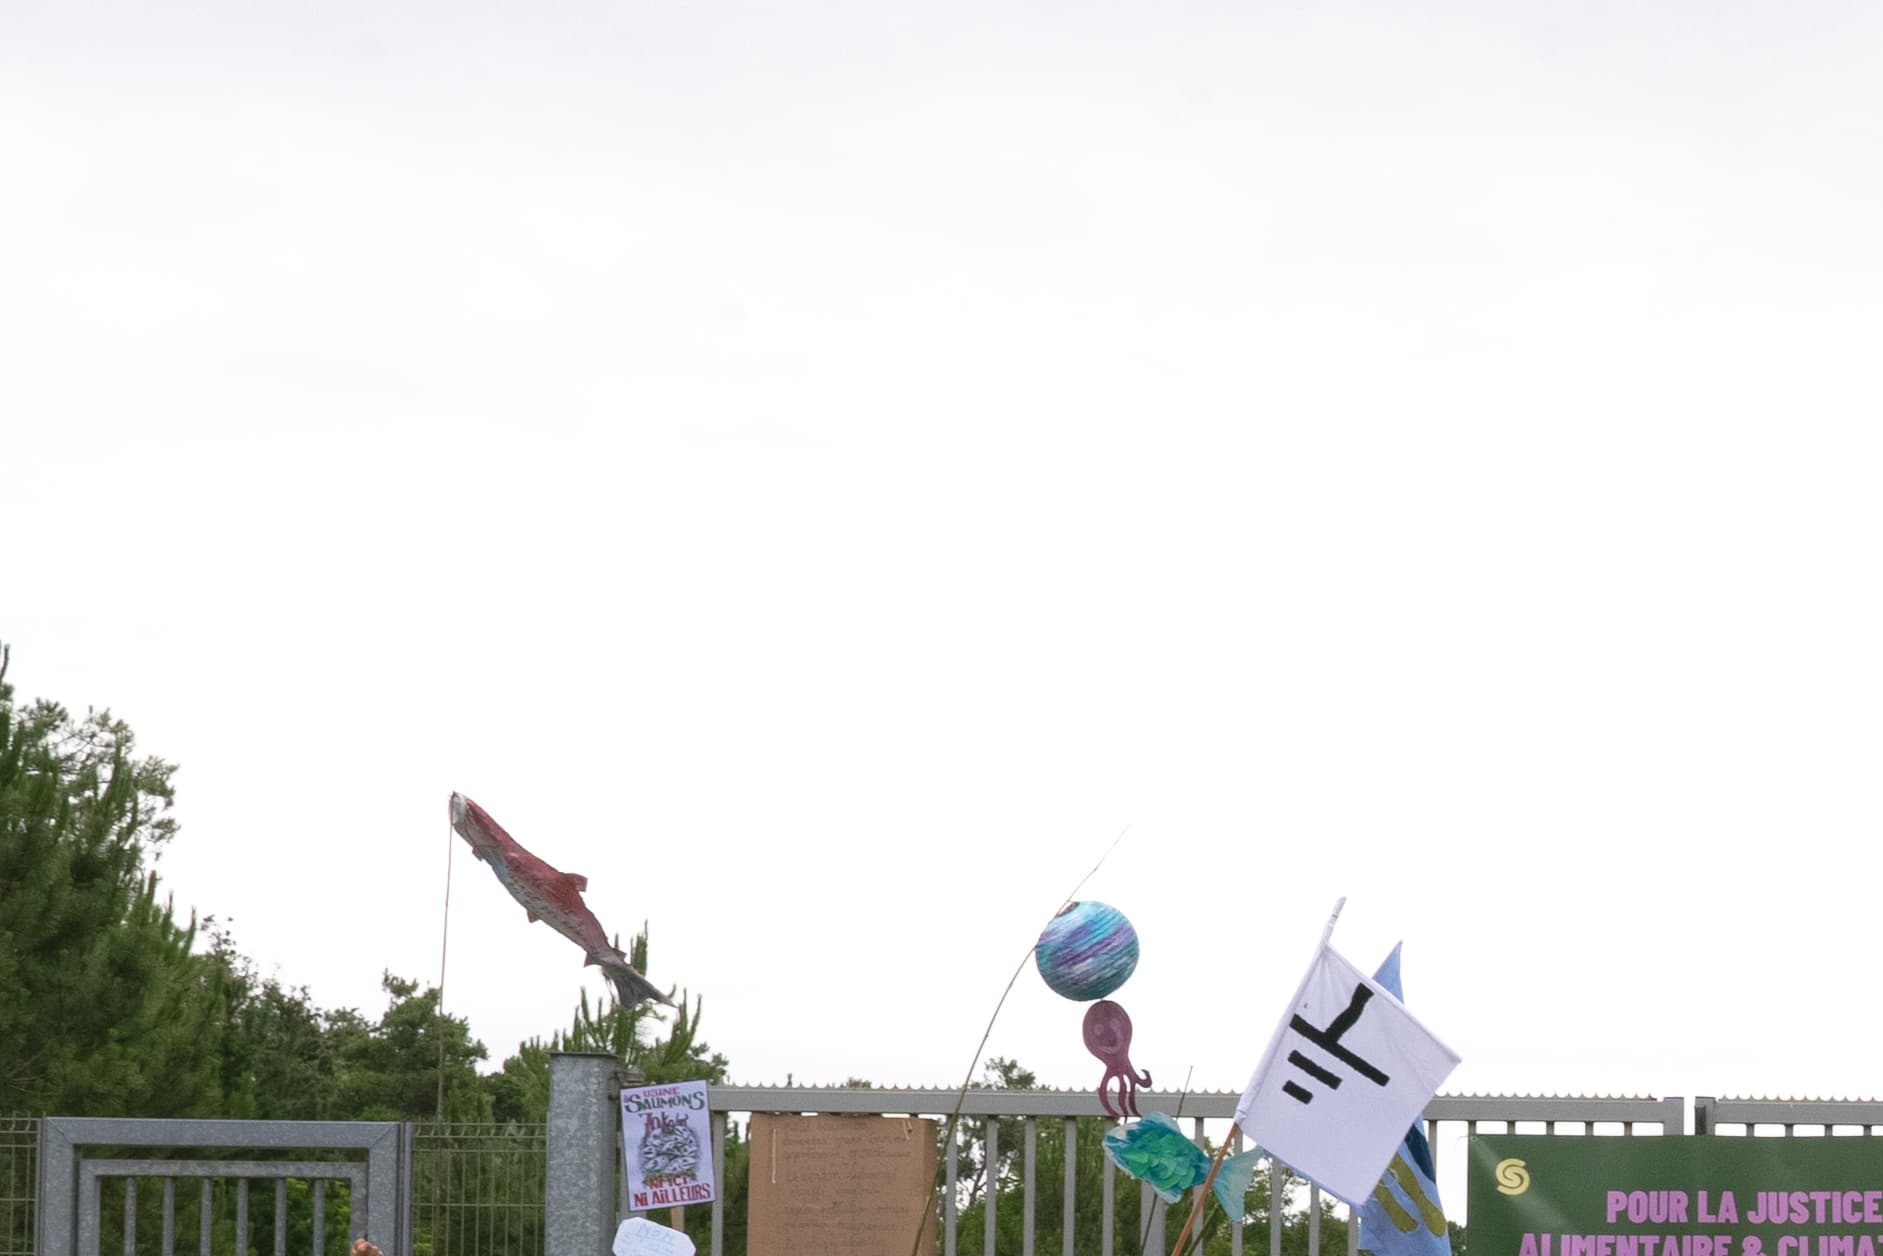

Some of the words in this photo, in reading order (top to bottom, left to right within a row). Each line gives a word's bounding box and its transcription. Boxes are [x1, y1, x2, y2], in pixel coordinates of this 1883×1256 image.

[625, 1091, 704, 1112] SAUMONS
[643, 1087, 680, 1097] USINE
[1606, 1190, 1688, 1224] POUR
[1697, 1190, 1739, 1224] LA
[1747, 1191, 1883, 1224] JUSTICE
